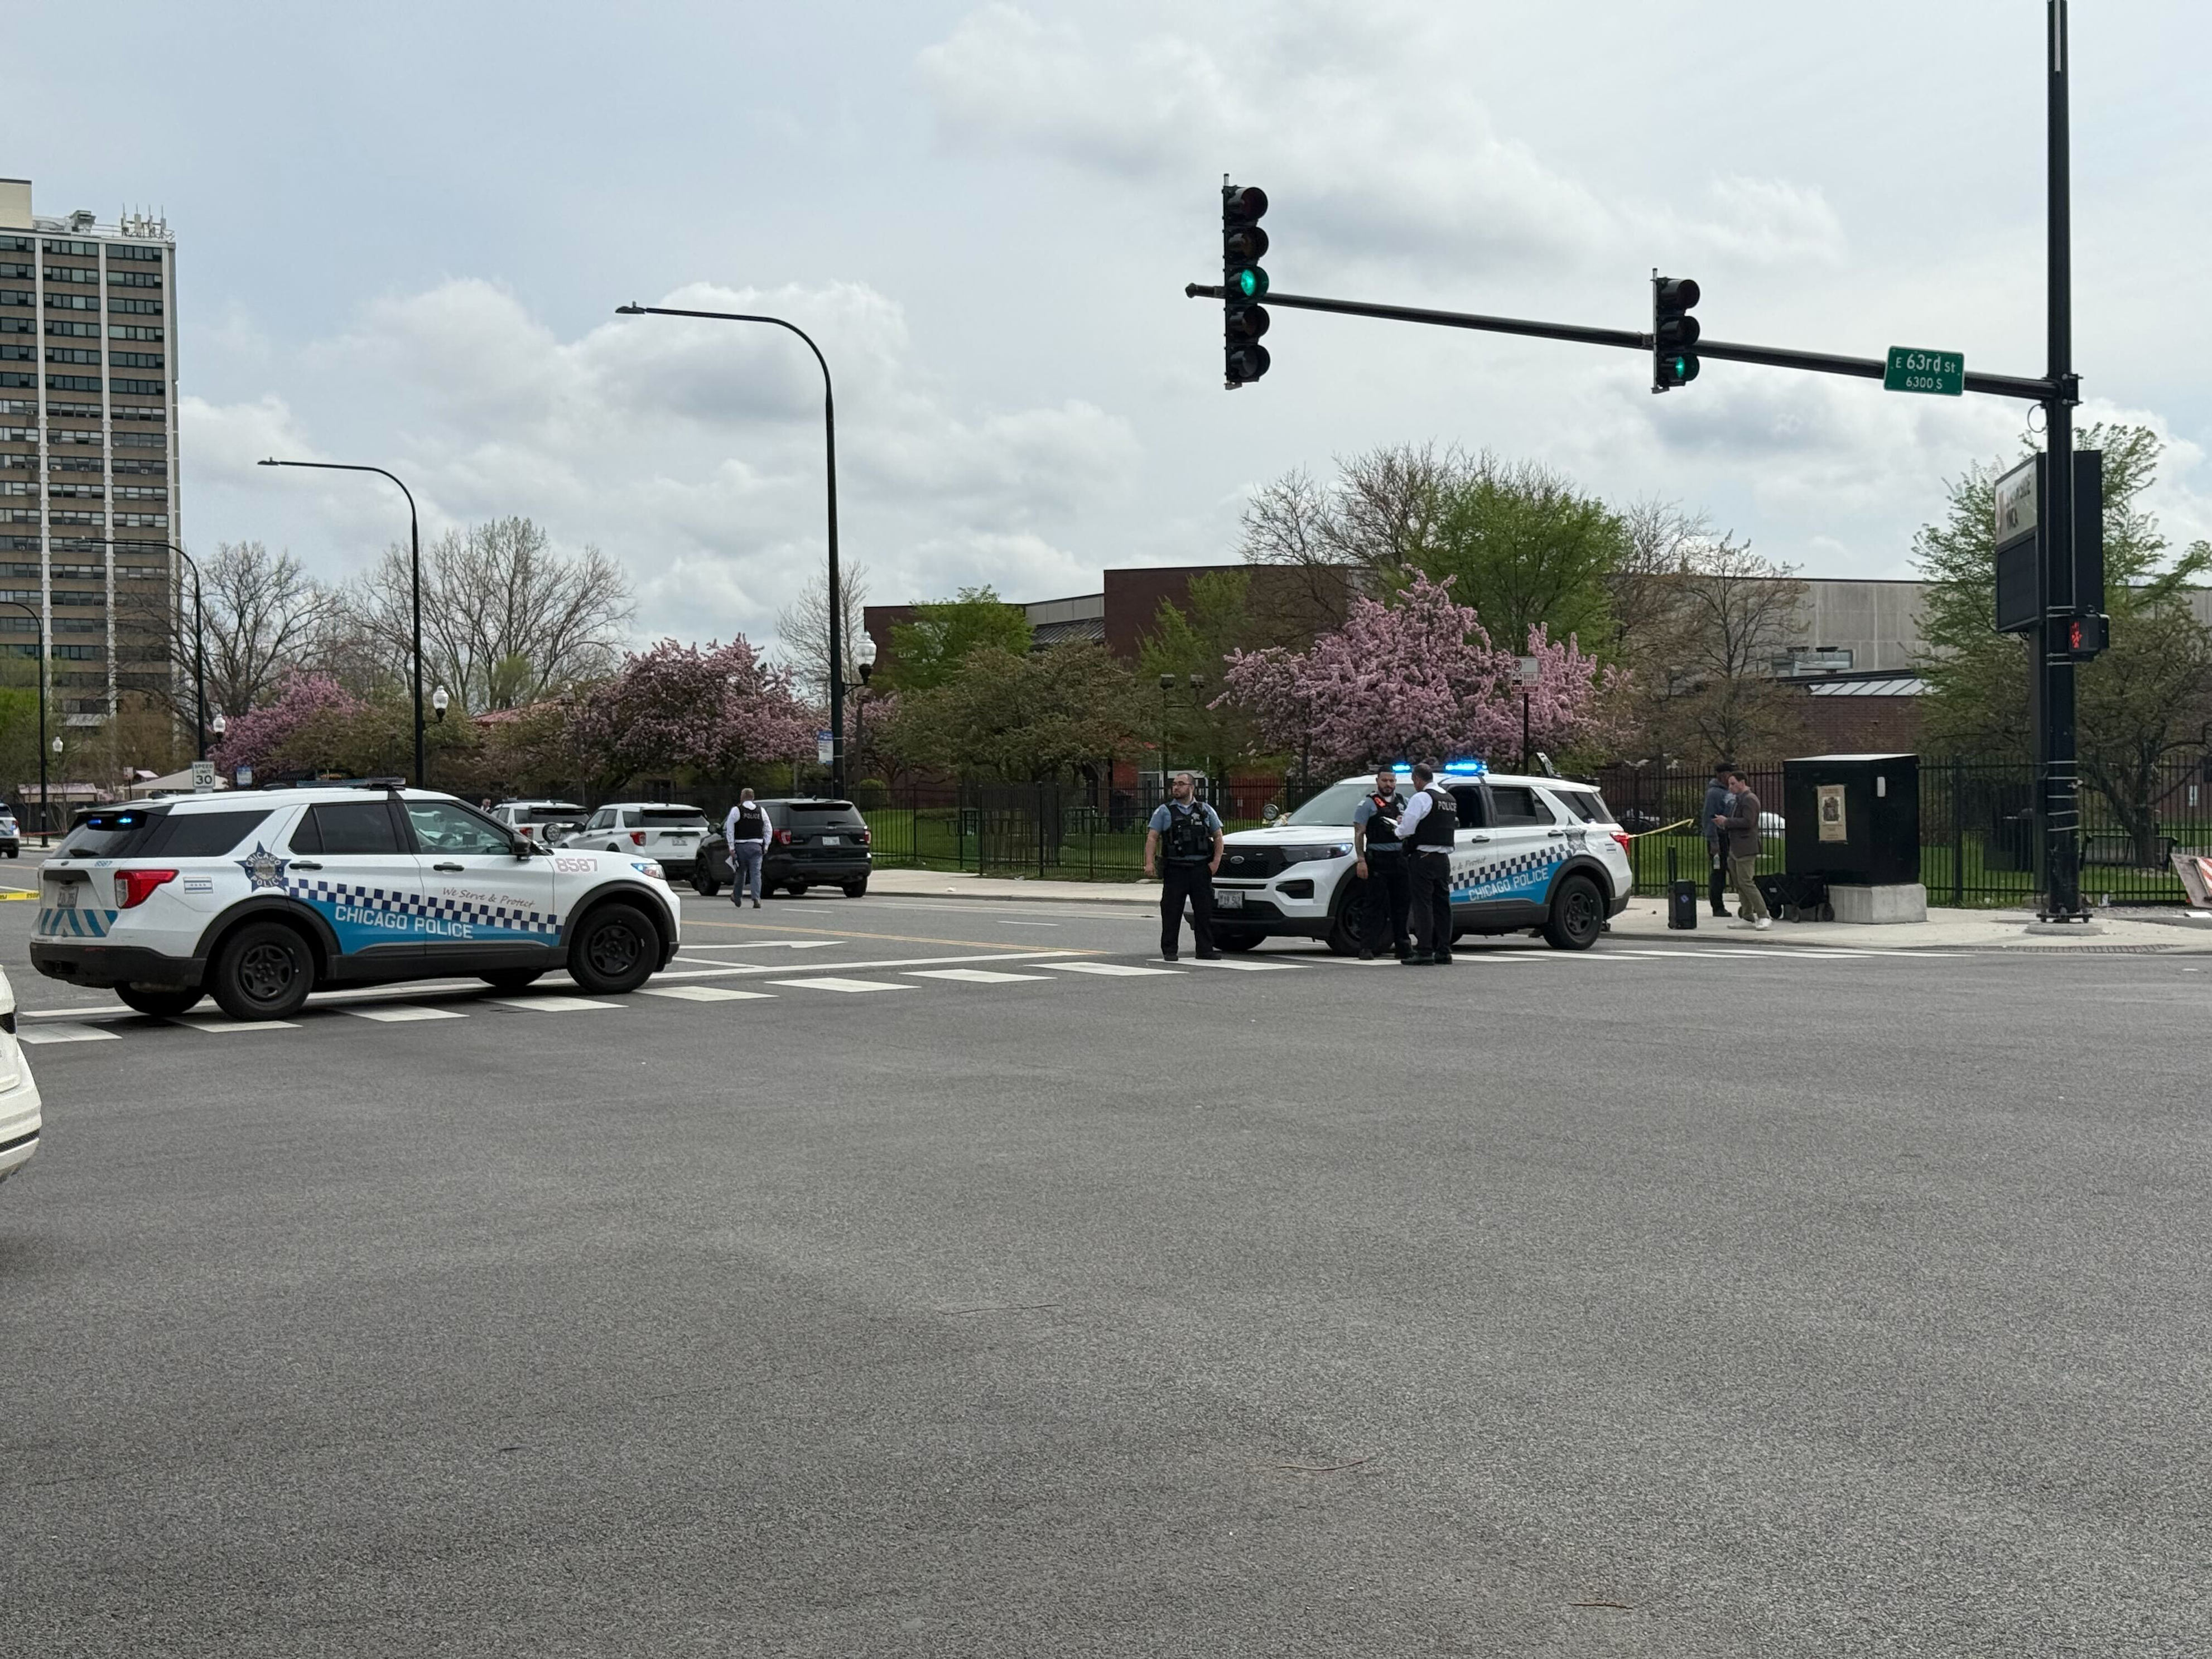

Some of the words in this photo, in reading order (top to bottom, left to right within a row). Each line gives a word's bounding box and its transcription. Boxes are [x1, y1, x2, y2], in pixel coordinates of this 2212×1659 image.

[1896, 357, 1902, 368] E
[1906, 353, 1940, 372] 63rd
[1906, 376, 1934, 389] 6300
[1936, 378, 1943, 389] S
[195, 775, 213, 784] 30
[246, 852, 281, 867] CHICAGO
[555, 858, 597, 872] 8587
[250, 875, 283, 887] POLICE
[1468, 879, 1511, 901] CHICAGO
[1513, 867, 1549, 889] POLICE
[443, 886, 457, 896] We
[459, 889, 486, 900] Serve
[488, 894, 497, 903] &
[500, 895, 536, 908] Protect
[335, 905, 408, 930] CHICAGO
[415, 917, 474, 939] POLICE
